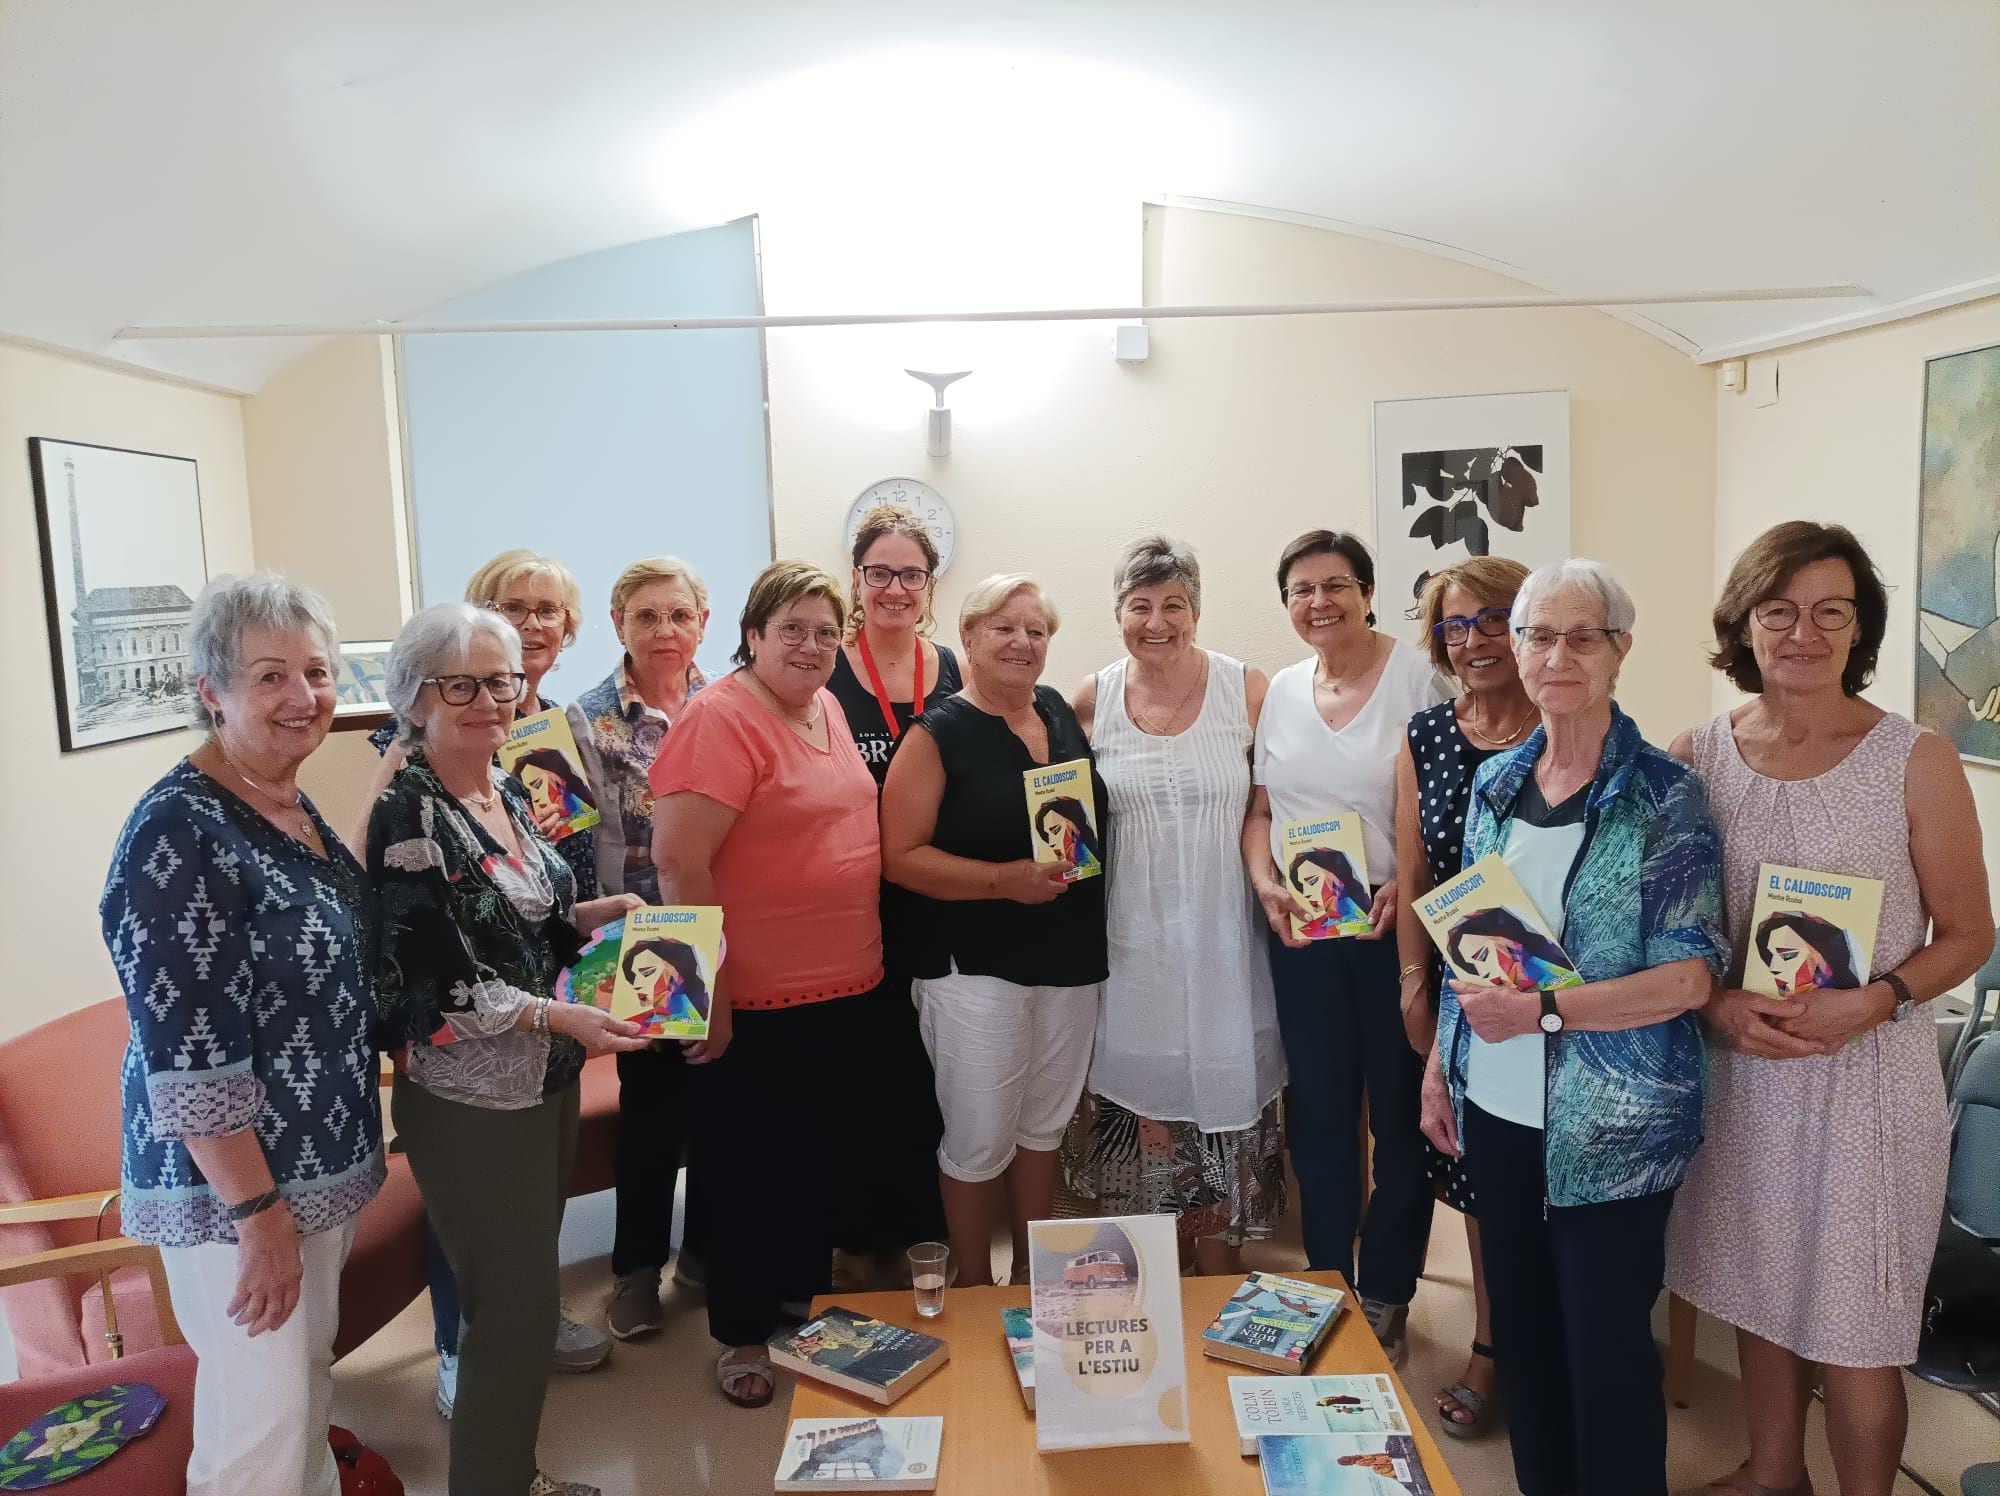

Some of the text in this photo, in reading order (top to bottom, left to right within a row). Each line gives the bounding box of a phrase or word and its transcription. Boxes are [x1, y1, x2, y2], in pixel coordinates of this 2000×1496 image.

[892, 491, 906, 502] 12
[927, 508, 937, 521] 2
[933, 526, 943, 538] 3
[1034, 769, 1077, 788] EL CALIDOSCOPI
[1288, 820, 1341, 839] EL CALIDOSCOPI
[1424, 903, 1437, 917] EL
[1434, 872, 1486, 910] CALIDOSCOPI
[1769, 875, 1852, 901] EL CALIDOSCOPI
[634, 912, 697, 924] EL CALIDOSCOPI
[1066, 1318, 1149, 1336] LECTURES
[1248, 1323, 1278, 1335] HIJO
[1240, 1328, 1278, 1343] BUEN
[1084, 1339, 1133, 1355] PER A
[1078, 1358, 1140, 1375] L'ESTIU
[1242, 1392, 1262, 1421] COLM
